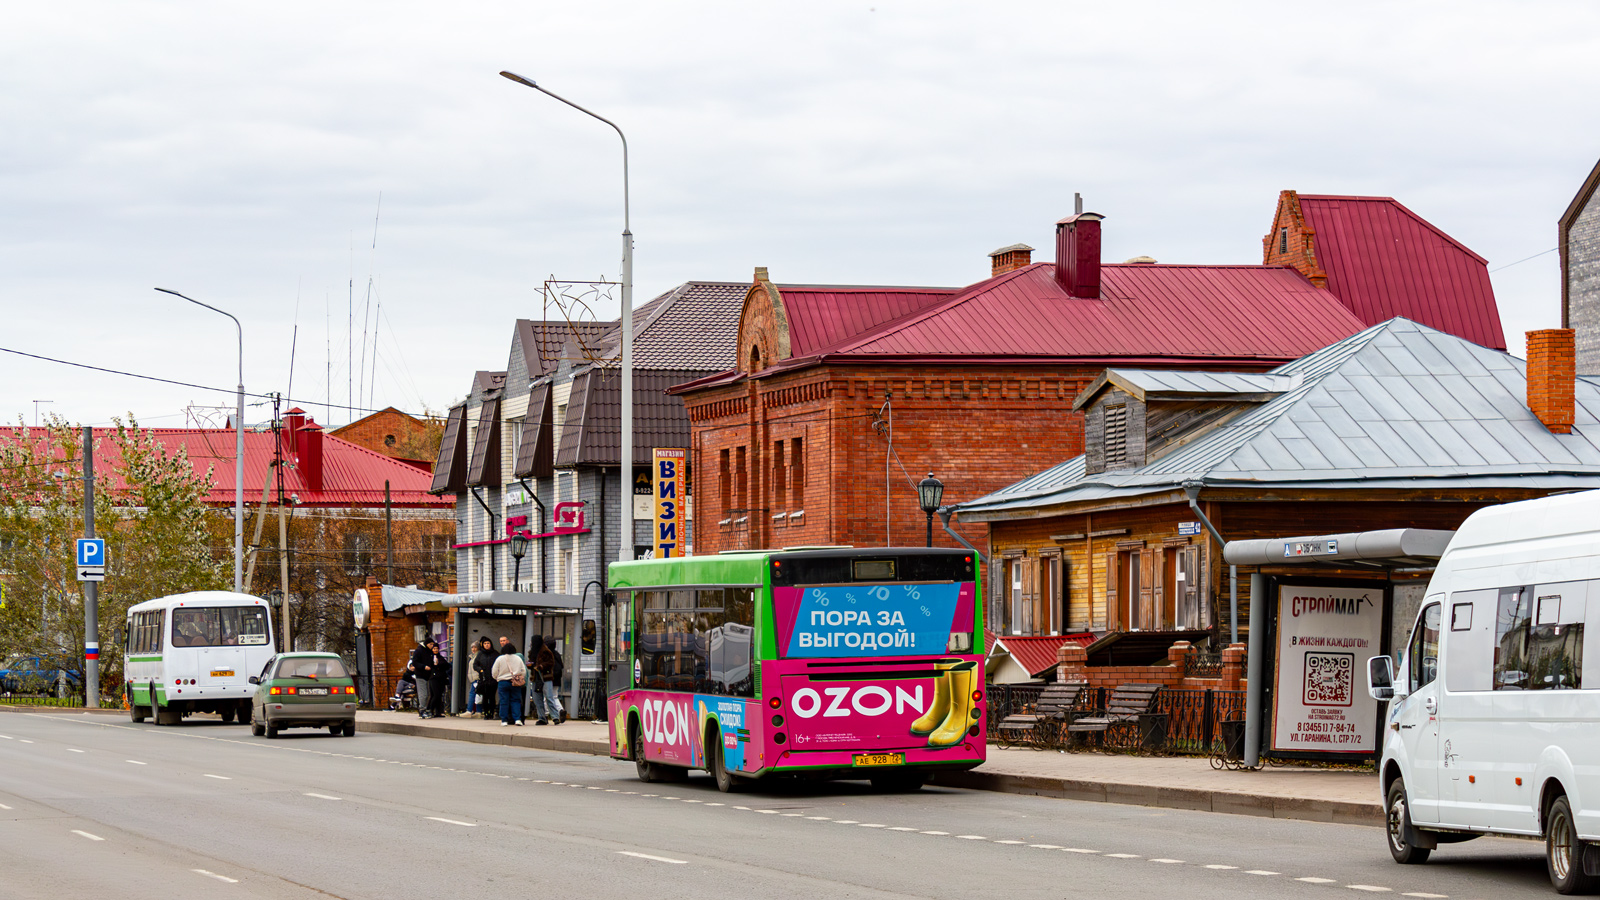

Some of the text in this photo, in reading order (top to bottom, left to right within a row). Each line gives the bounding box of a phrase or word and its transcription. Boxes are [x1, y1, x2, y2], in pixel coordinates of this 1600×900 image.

[656, 450, 684, 458] МАГАЗИН
[659, 460, 676, 558] ВИЗИТ
[83, 542, 98, 563] P
[1292, 595, 1364, 618] СТРОЙМАГ
[811, 610, 905, 626] ПОРА ЗА
[240, 635, 245, 644] 2
[798, 629, 916, 650] ВЫГОДОЙ!
[1292, 636, 1297, 646] В
[1298, 636, 1325, 647] ЖИЗНИ
[791, 685, 923, 718] OZON
[642, 698, 690, 746] OZON
[1297, 722, 1355, 733] 8 (34551) 7-84-74
[795, 733, 811, 744] 16+
[1290, 733, 1300, 742] УЛ.
[1301, 733, 1332, 744] ГАРАНИНА,
[1338, 735, 1350, 744] СТР
[1350, 735, 1362, 744] 7/2
[872, 755, 887, 764] 928
